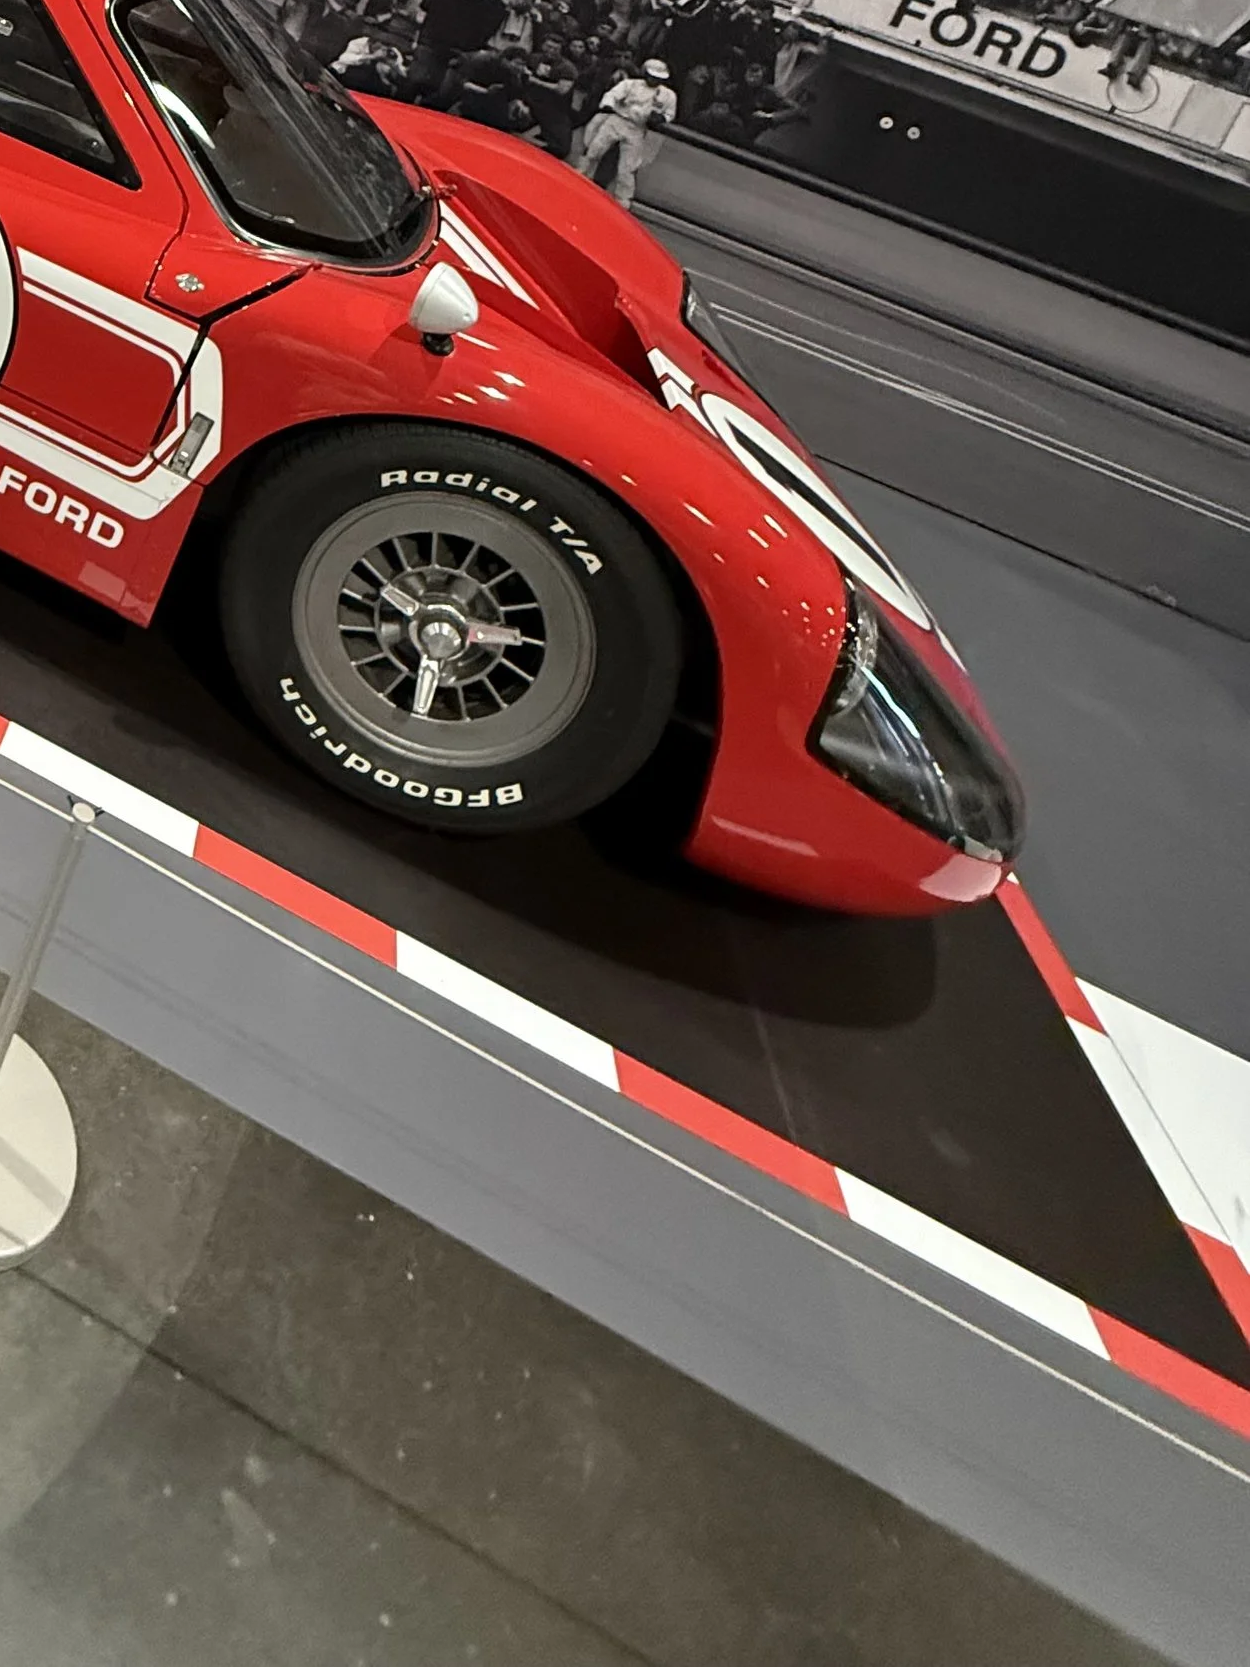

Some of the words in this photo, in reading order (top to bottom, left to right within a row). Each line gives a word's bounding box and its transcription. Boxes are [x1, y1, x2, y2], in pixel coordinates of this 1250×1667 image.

[380, 469, 538, 512] Radial
[549, 516, 603, 575] T/A
[279, 678, 524, 807] BFGoodrich
